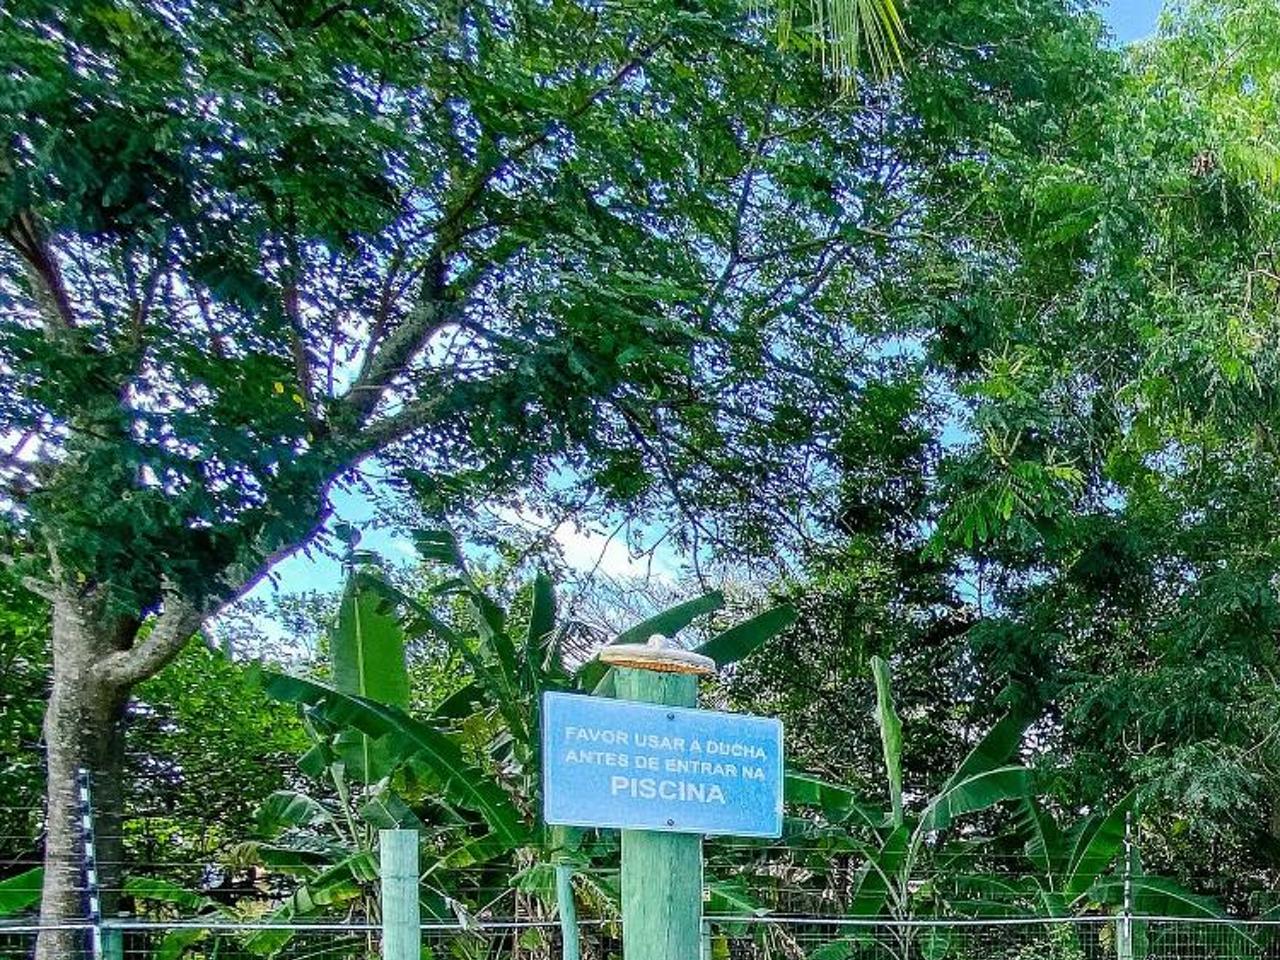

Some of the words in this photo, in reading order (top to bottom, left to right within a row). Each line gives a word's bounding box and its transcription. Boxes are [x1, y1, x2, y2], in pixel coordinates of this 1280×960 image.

[565, 726, 629, 745] FAVOR
[635, 733, 685, 751] USAR
[690, 738, 702, 752] A
[565, 750, 629, 768] ANTES
[635, 755, 660, 770] DE
[665, 760, 738, 777] ENTRAR
[742, 766, 765, 780] NA
[611, 776, 725, 804] PISCINA
